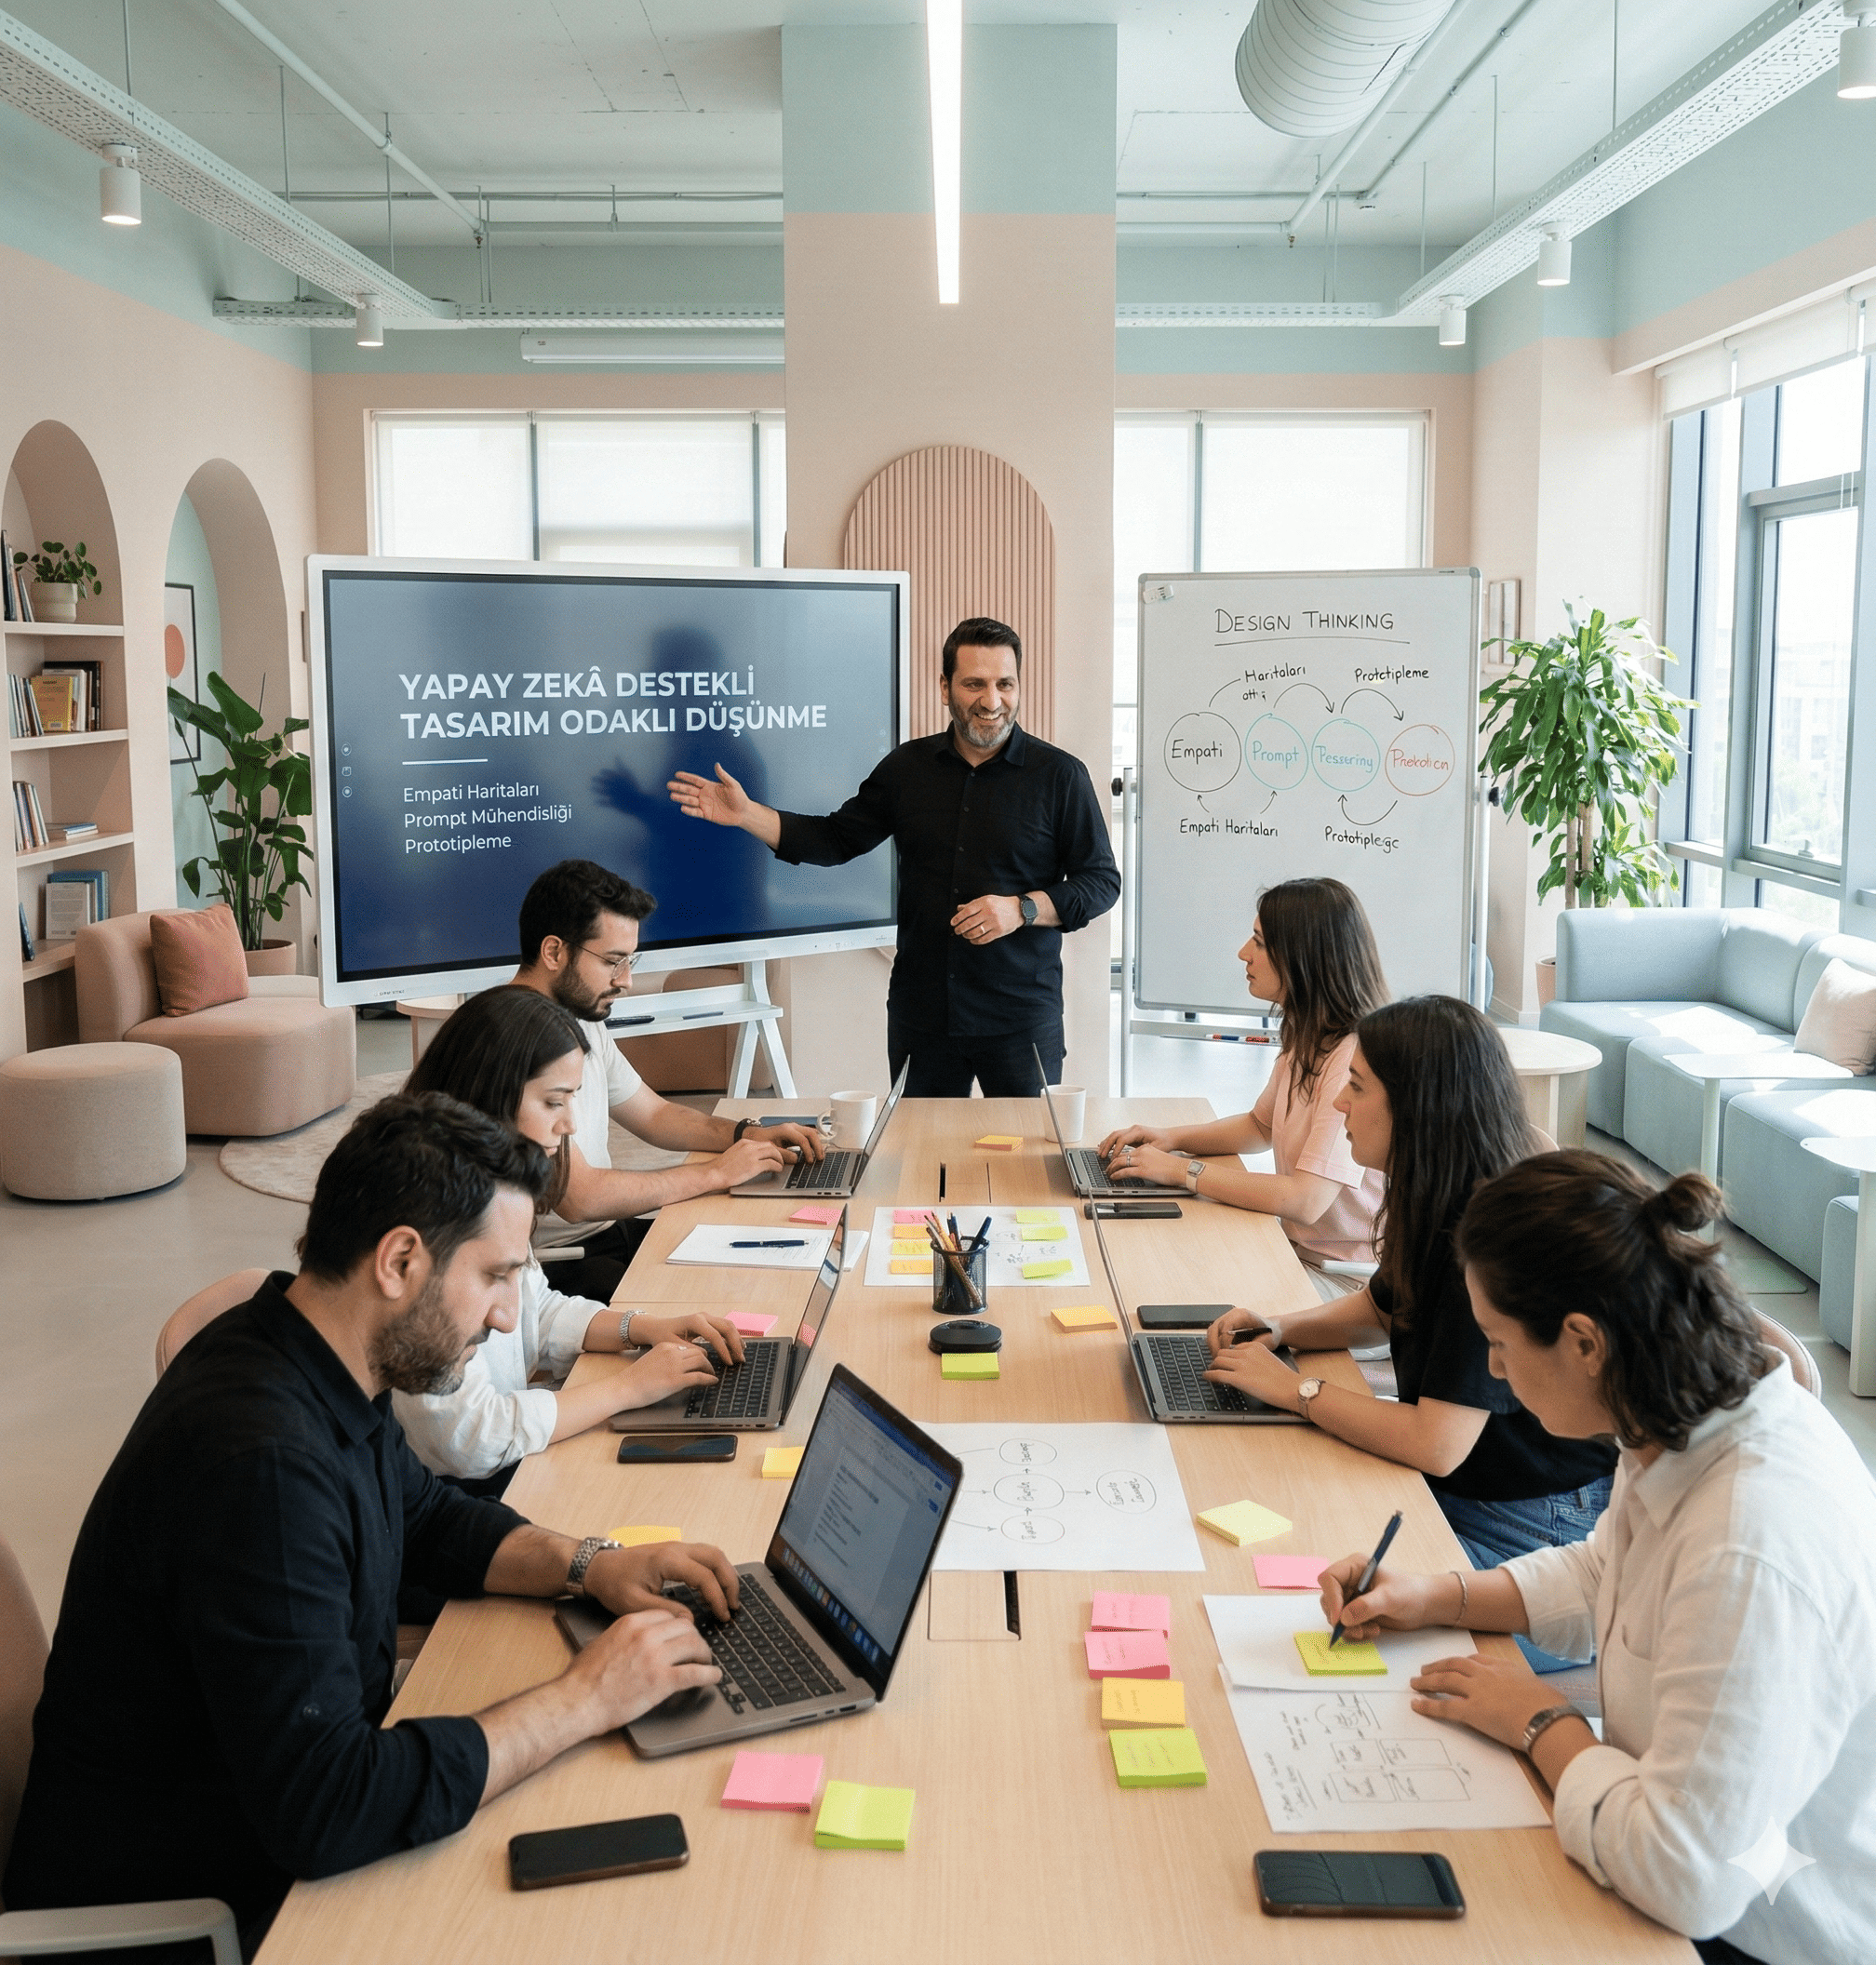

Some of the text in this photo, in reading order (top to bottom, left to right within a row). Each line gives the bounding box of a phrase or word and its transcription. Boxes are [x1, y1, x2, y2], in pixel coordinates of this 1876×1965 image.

[1214, 608, 1395, 634] DESIGN THINKING
[398, 664, 755, 700] YAPAY ZEKÂ DESTEKLİ
[399, 700, 827, 739] TASARIM ODAKLI DÜŞÜNME
[1172, 739, 1223, 765] Empati
[1253, 740, 1300, 769] Prompt
[404, 782, 540, 805] Empati Haritaları
[404, 811, 467, 829] Prompt
[1180, 817, 1279, 837] Empati Haritaları
[405, 835, 512, 854] Prototipleme
